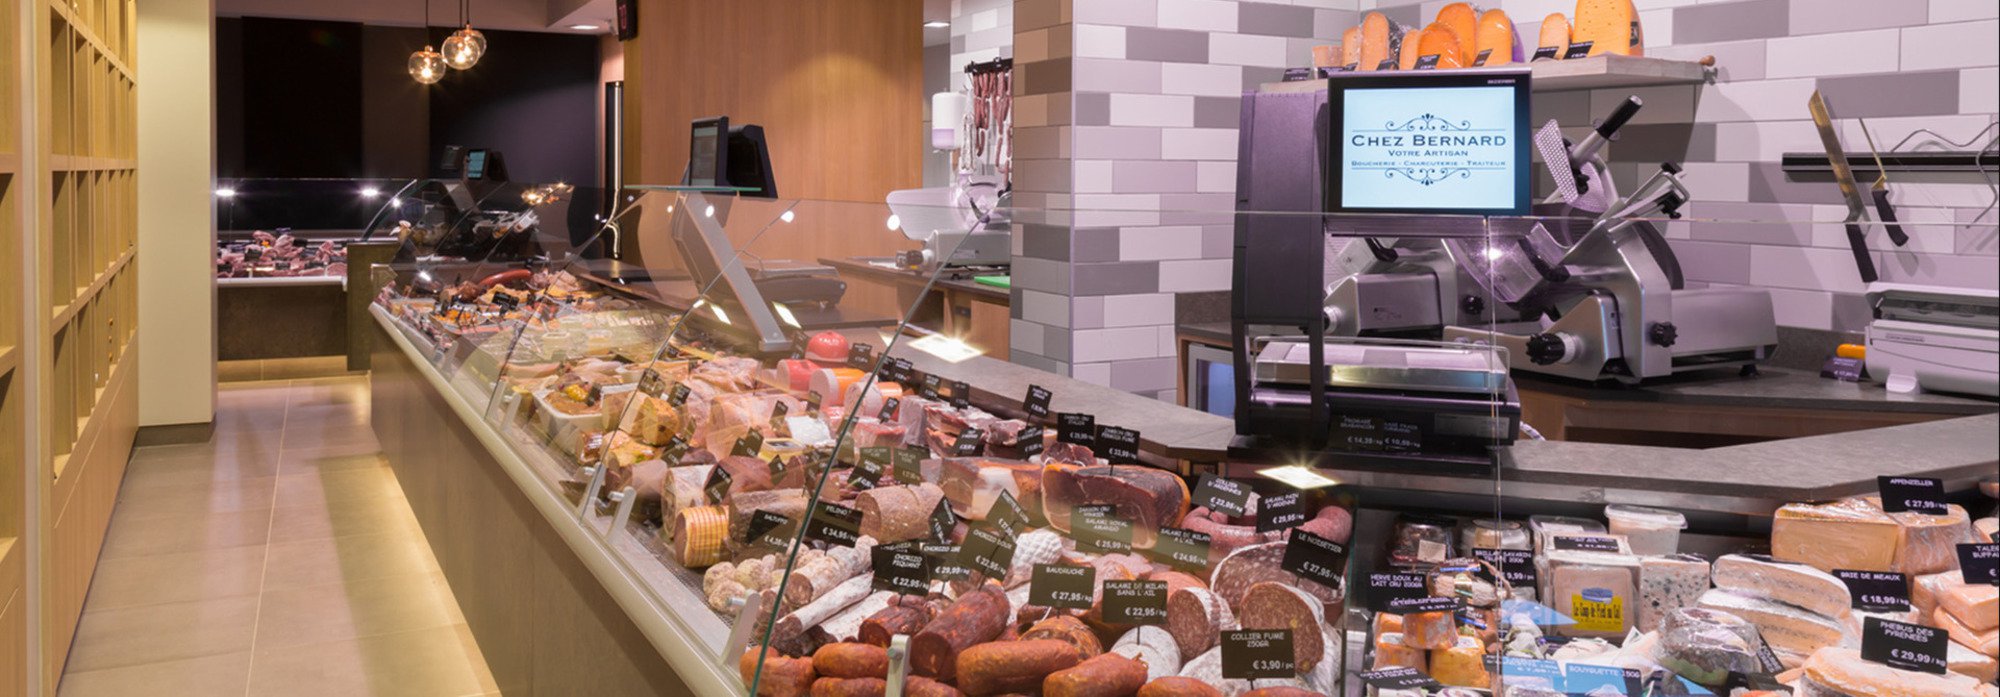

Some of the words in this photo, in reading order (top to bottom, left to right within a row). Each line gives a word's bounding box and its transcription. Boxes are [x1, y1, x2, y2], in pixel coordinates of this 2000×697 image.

[1352, 134, 1403, 147] CHEZ
[1413, 134, 1506, 147] BERNARD
[1388, 149, 1420, 157] VOTRE
[1424, 149, 1469, 157] ARTISAN
[1904, 499, 1910, 508] €
[1912, 500, 1935, 509] 27,99
[1299, 533, 1307, 543] LE
[1309, 563, 1331, 579] 27,95
[1989, 568, 1997, 577] €
[1370, 573, 1392, 582] HERVE
[1393, 574, 1412, 583] DOUX
[1873, 573, 1901, 581] MEAUX
[1105, 581, 1132, 590] SALAMI
[1145, 582, 1168, 590] MILAN
[1051, 591, 1058, 600] €
[1059, 592, 1082, 601] 27,95
[1117, 589, 1136, 597] SANS
[1861, 594, 1869, 603] €
[1870, 595, 1896, 605] 18,99
[1125, 607, 1131, 617] €
[1132, 607, 1155, 617] 22,95
[1880, 621, 1914, 634] PHEBUS
[1916, 627, 1934, 637] DES
[1230, 632, 1261, 641] COLLIER
[1891, 648, 1899, 658] €
[1901, 650, 1931, 663] 29,99
[1252, 660, 1260, 670] €
[1260, 660, 1281, 671] 3,90
